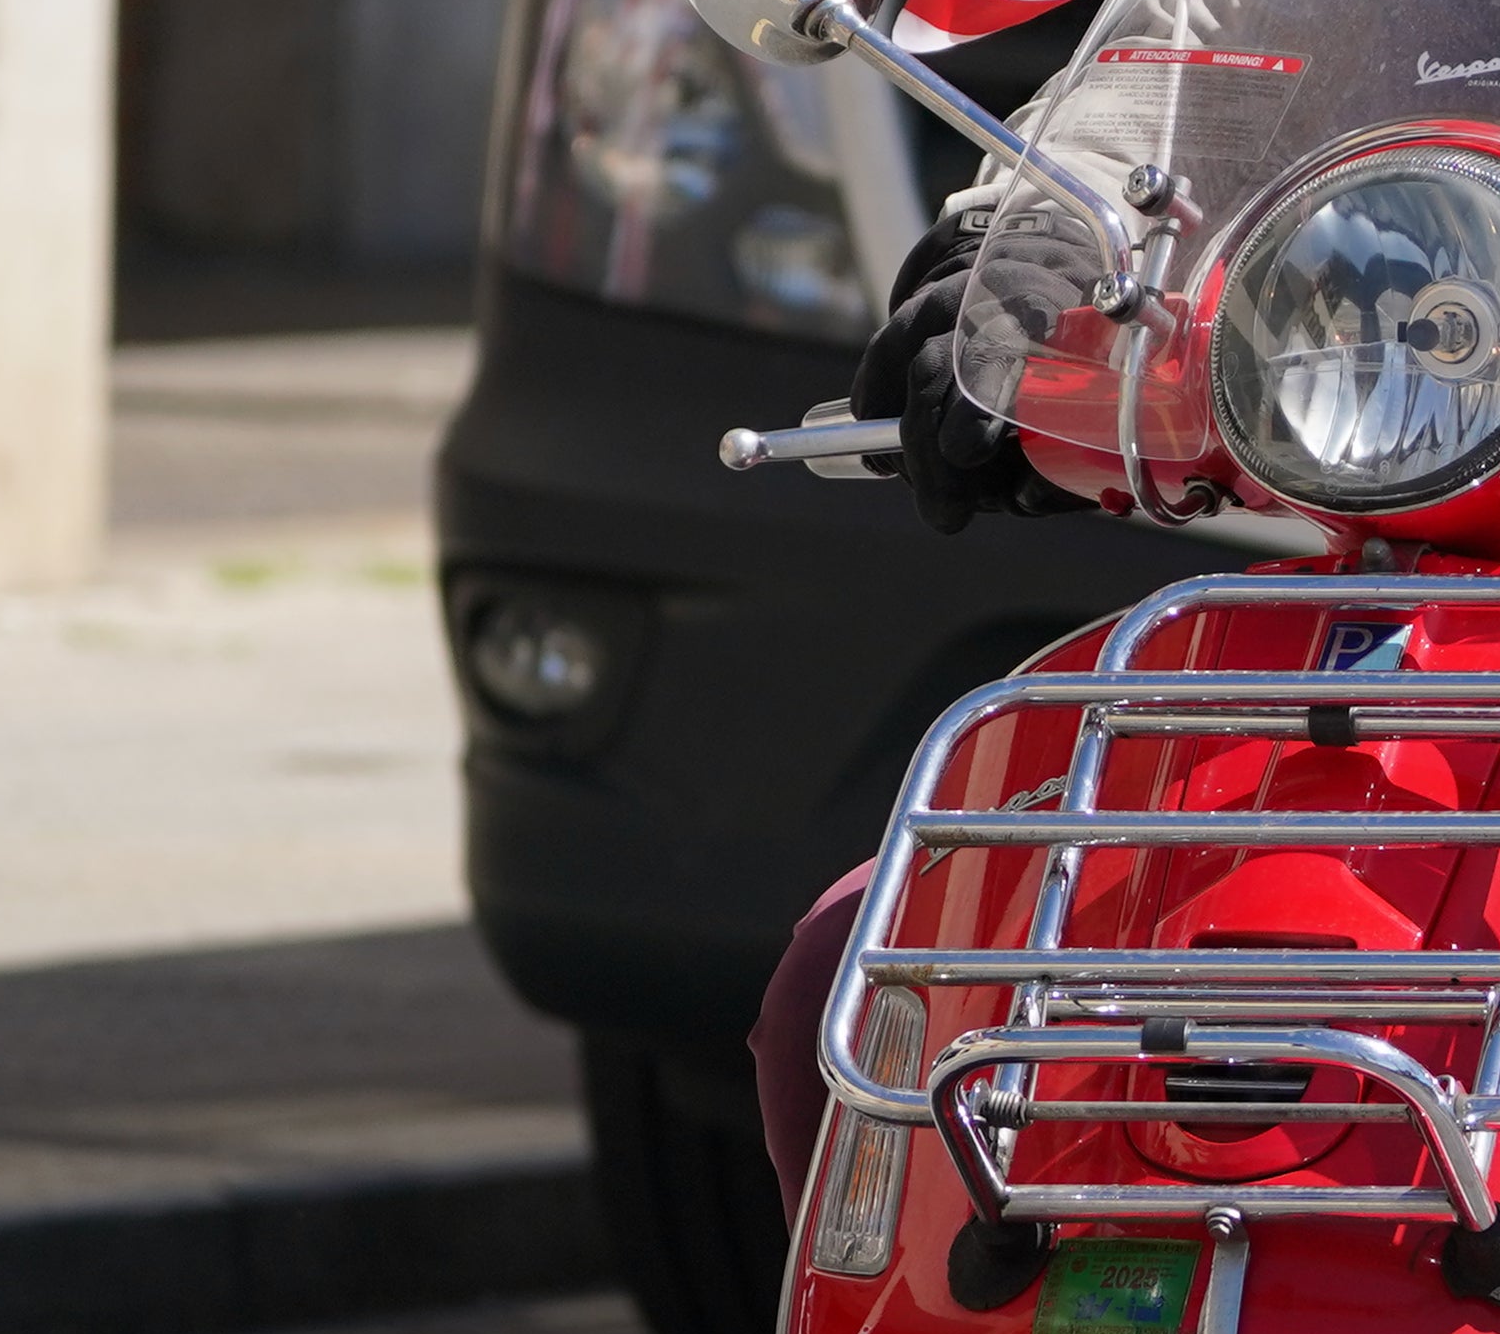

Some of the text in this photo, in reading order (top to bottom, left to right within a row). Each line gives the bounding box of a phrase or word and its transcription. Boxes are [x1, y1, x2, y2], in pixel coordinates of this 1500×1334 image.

[1128, 50, 1265, 67] ATTENZIONE! WARNING!
[1100, 1265, 1160, 1290] 2025
